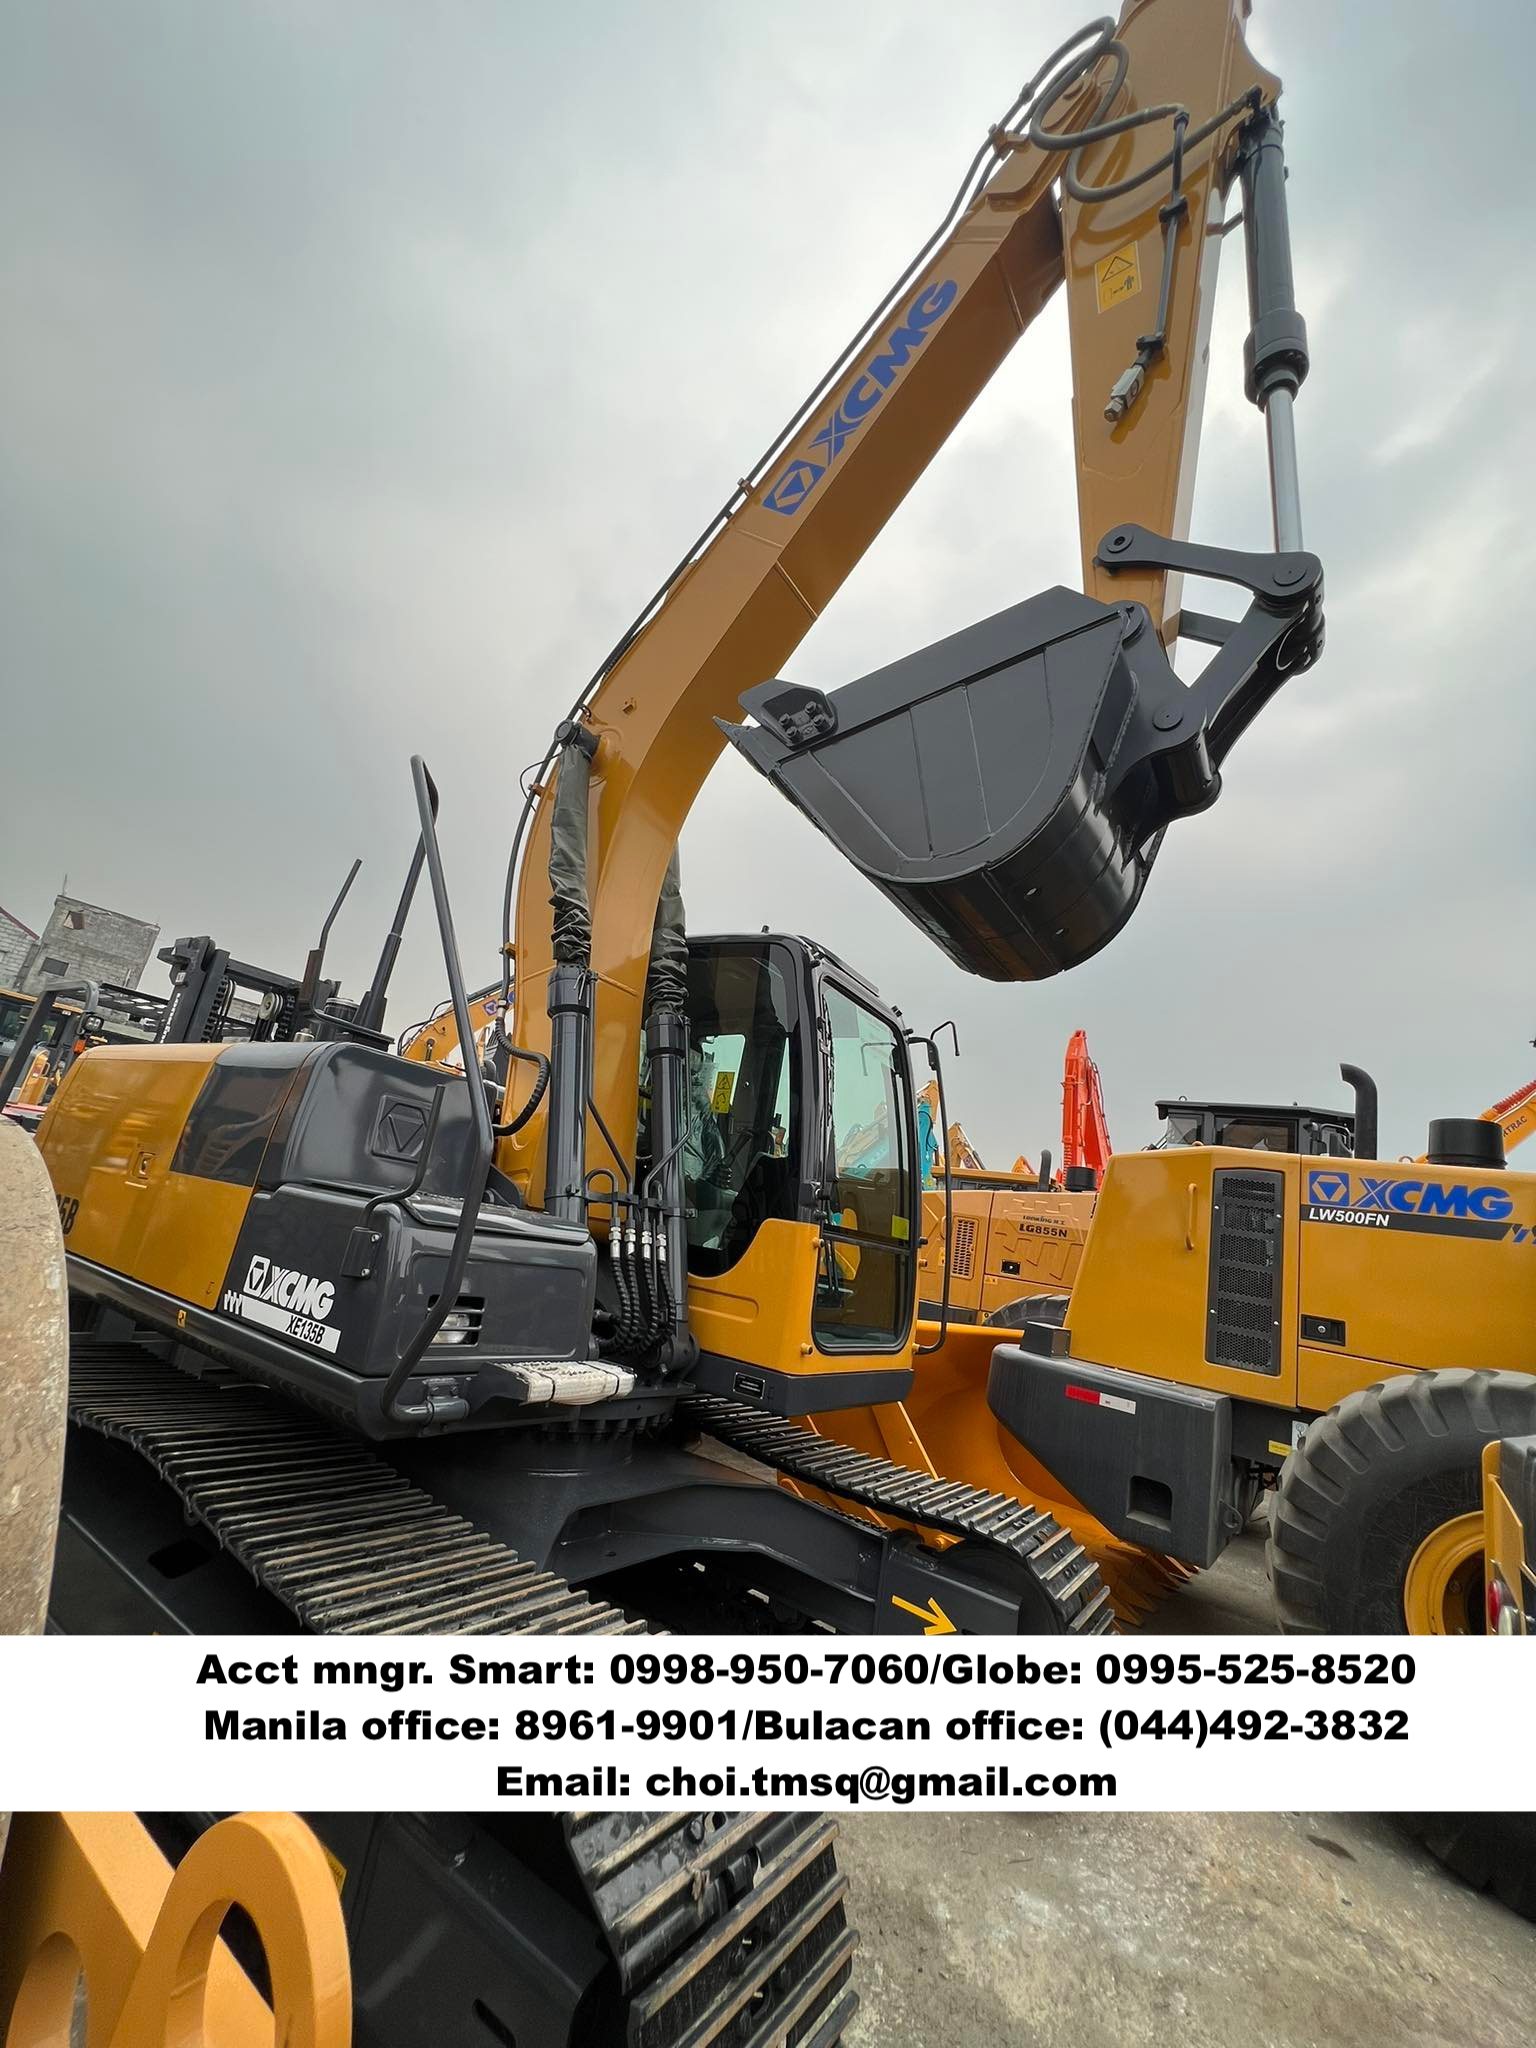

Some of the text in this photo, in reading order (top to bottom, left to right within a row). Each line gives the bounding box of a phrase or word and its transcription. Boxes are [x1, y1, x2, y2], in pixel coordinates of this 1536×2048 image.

[808, 280, 958, 467] XCMG
[1309, 1207, 1390, 1227] LW500FN
[1352, 1178, 1513, 1220] XCMG
[1019, 1223, 1068, 1238] LG855N
[260, 1265, 335, 1320] XCMG
[286, 1315, 326, 1345] XE135B
